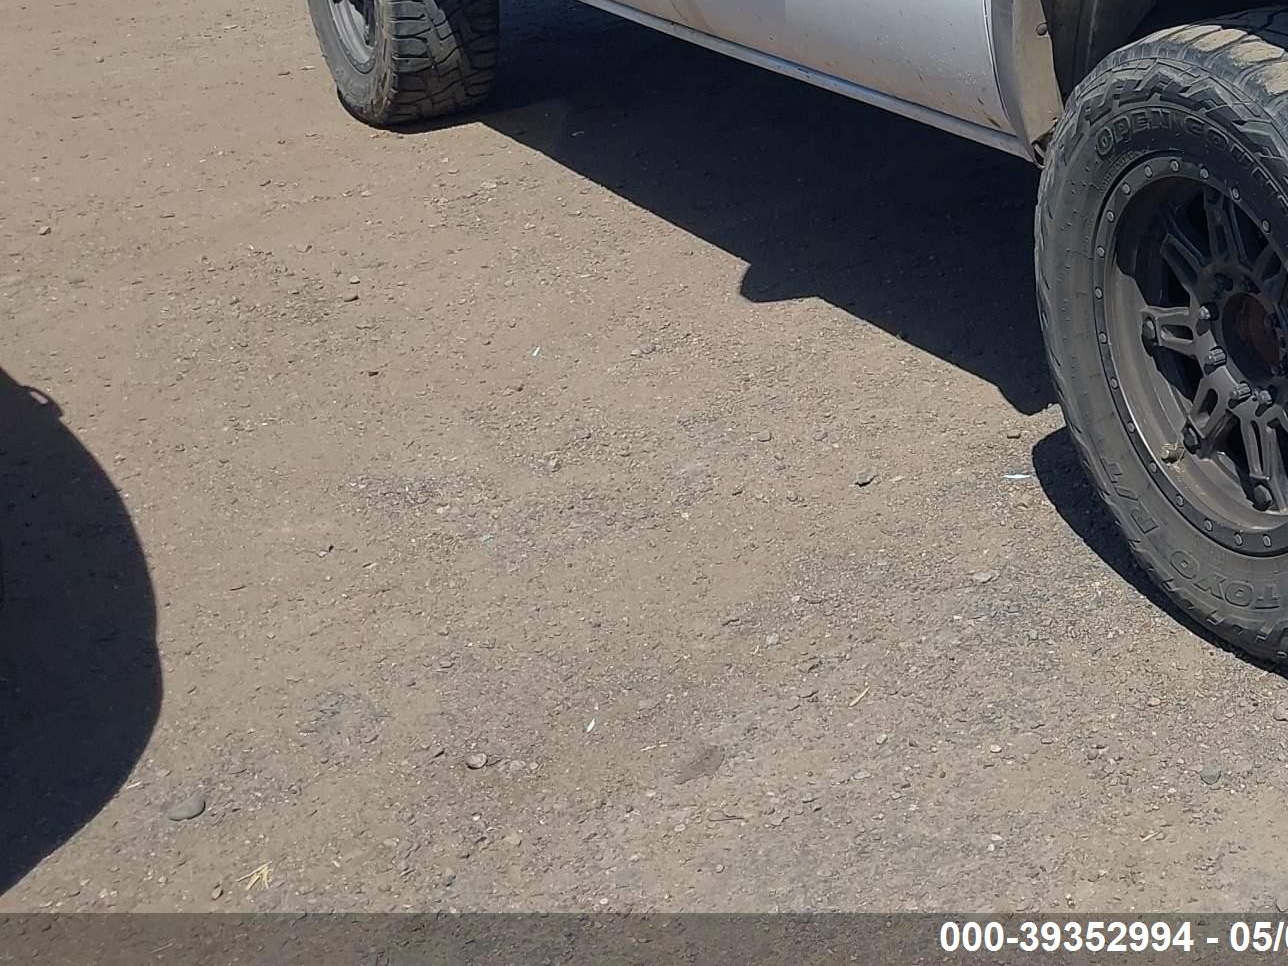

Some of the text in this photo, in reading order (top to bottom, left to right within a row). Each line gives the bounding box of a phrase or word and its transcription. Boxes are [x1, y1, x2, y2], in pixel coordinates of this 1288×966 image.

[1094, 108, 1179, 156] OPEN
[1100, 458, 1159, 534] R/T
[1168, 548, 1281, 611] TOYO
